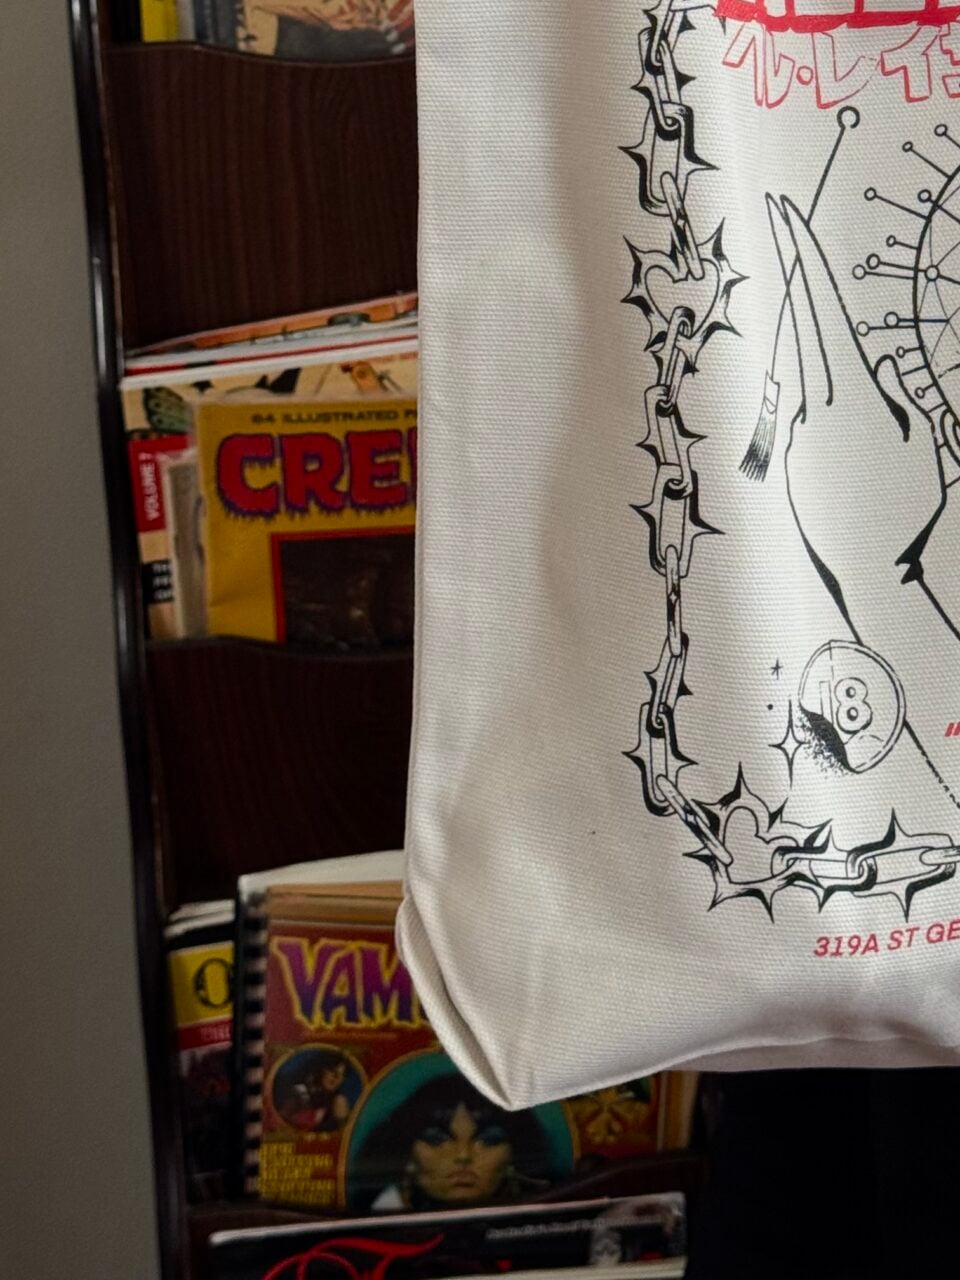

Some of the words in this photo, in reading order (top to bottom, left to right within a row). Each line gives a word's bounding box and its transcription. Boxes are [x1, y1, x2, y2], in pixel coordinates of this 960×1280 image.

[281, 409, 399, 425] ILLUSTRATED
[217, 426, 418, 520] CRE
[814, 933, 880, 958] 319A
[887, 927, 919, 951] ST
[272, 937, 431, 1029] VAM
